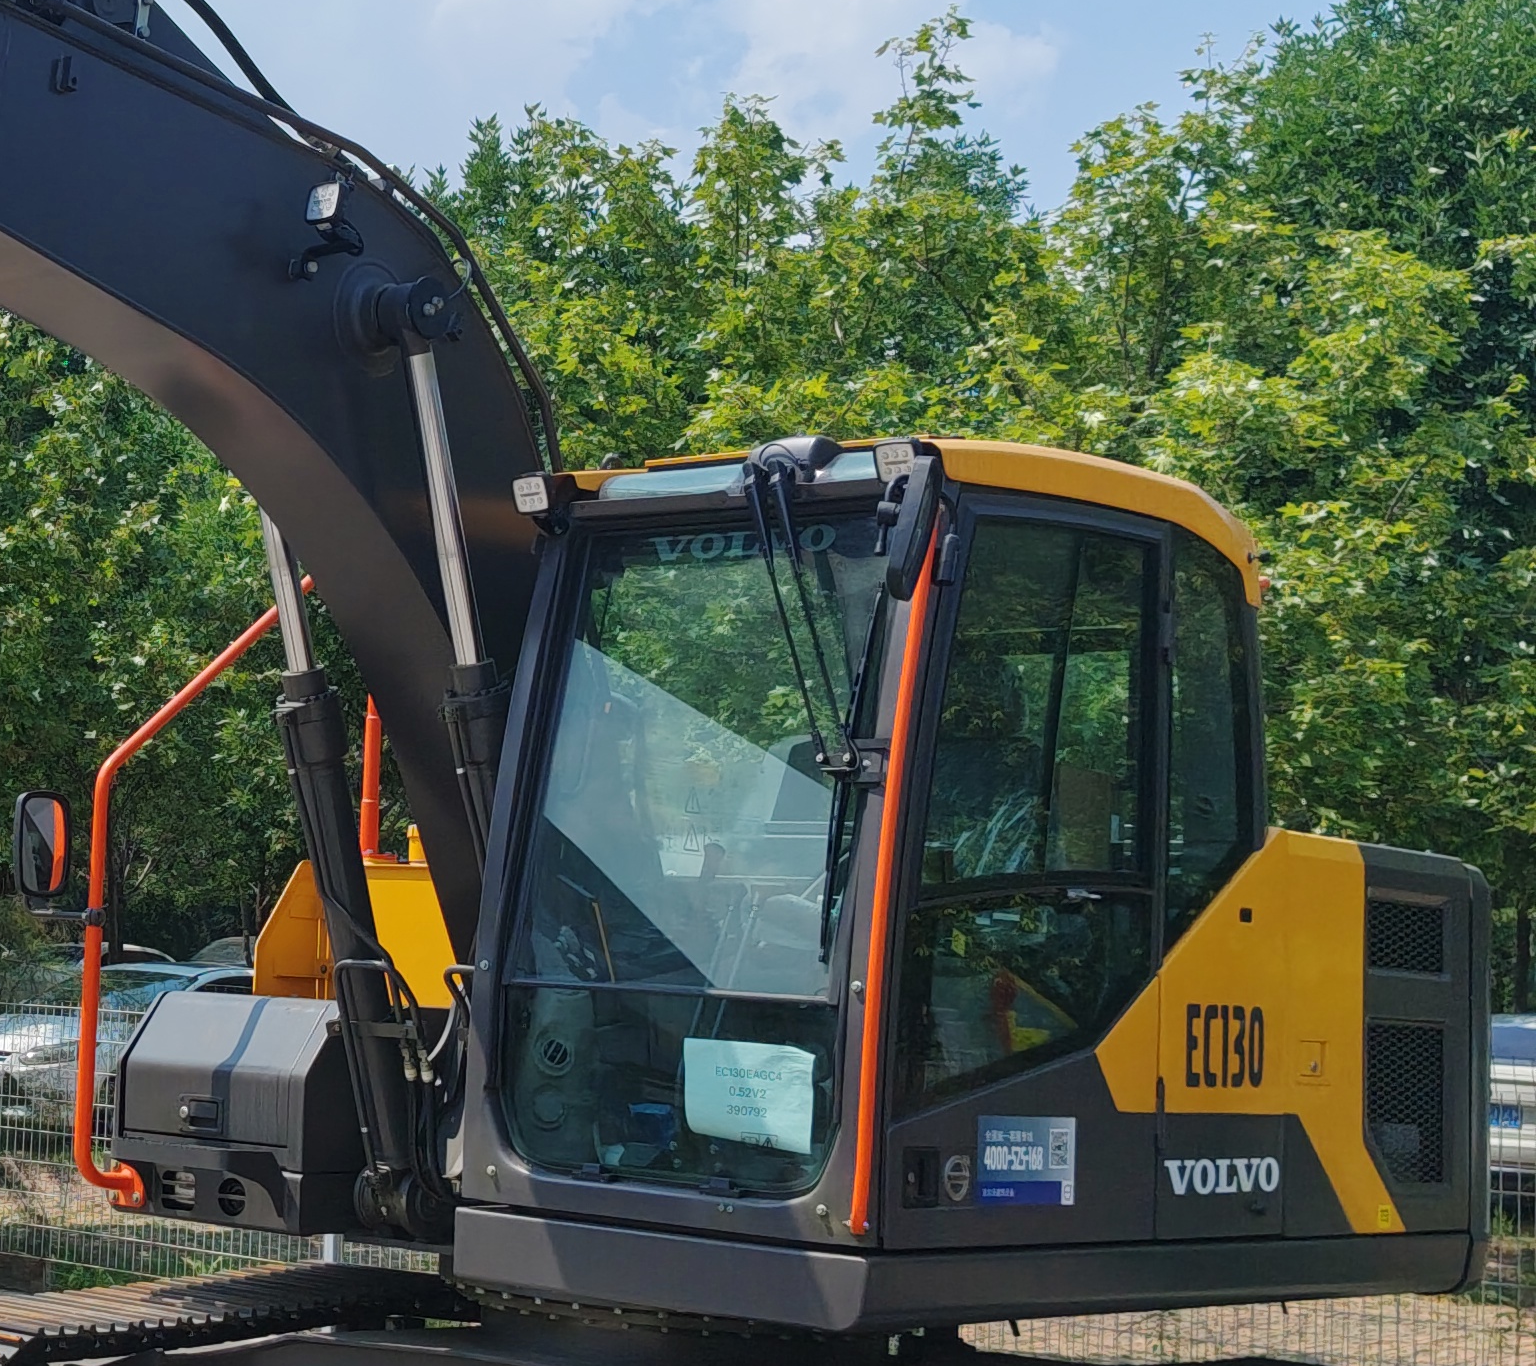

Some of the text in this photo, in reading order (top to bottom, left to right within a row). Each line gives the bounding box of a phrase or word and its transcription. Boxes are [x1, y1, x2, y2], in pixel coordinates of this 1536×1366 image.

[1185, 1003, 1264, 1089] EC130
[715, 1065, 783, 1082] EC130EAGC4
[726, 1104, 768, 1119] 390792
[1164, 1156, 1280, 1196] VOLVO
